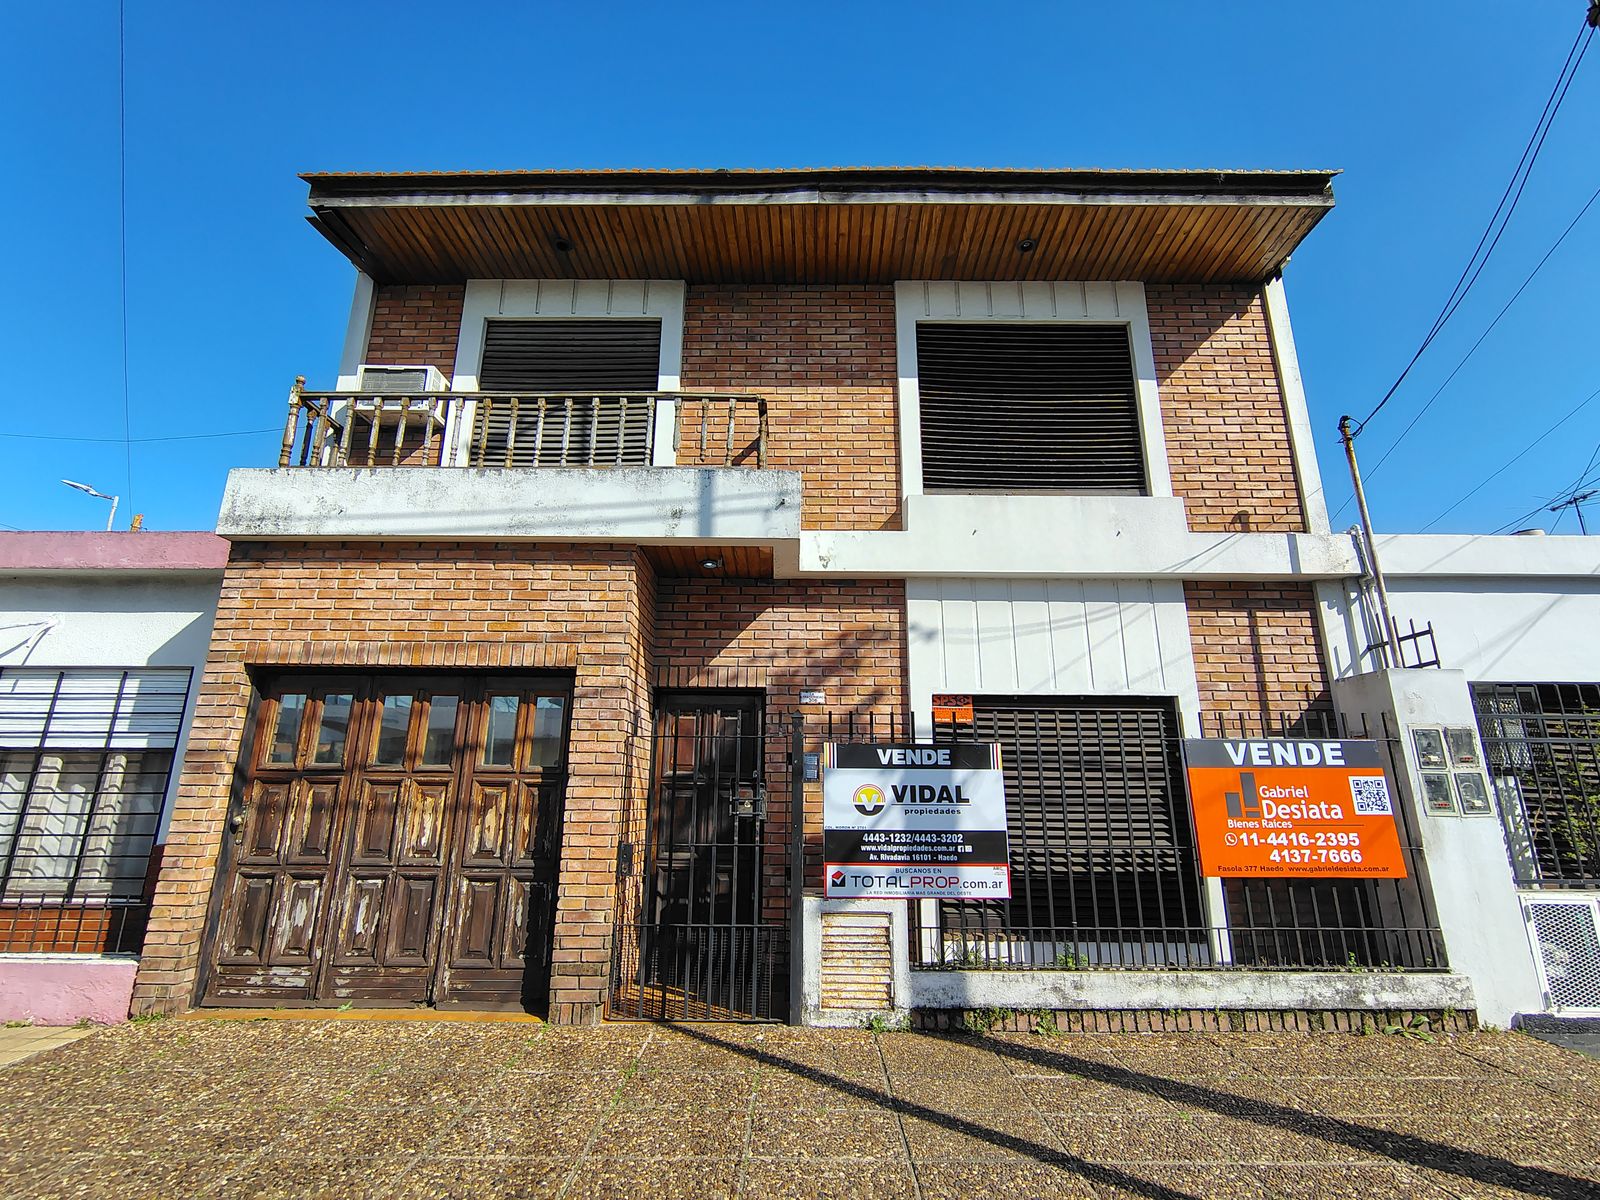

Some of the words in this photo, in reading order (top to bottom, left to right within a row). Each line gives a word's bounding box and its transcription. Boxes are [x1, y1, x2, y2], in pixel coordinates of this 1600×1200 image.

[877, 748, 951, 765] VENDE
[1223, 742, 1346, 766] VENDE
[891, 784, 970, 804] VIDAL
[1259, 785, 1309, 798] Gabriel
[904, 807, 962, 816] propiedades
[1262, 799, 1344, 820] Desiata
[1227, 819, 1260, 829] Bienes
[862, 833, 964, 843] 4443-1232/4443-3202
[1239, 832, 1361, 847] 11-4416-2395
[860, 844, 956, 852] www.vidalpropiedades.com.ar
[869, 853, 879, 861] Av.
[880, 853, 911, 861] Rivadavia
[1269, 849, 1363, 863] 4137-7666
[1288, 865, 1389, 874] www.gabrieldesiata.com.ar
[850, 875, 1003, 889] TOTALPROP.com.ar
